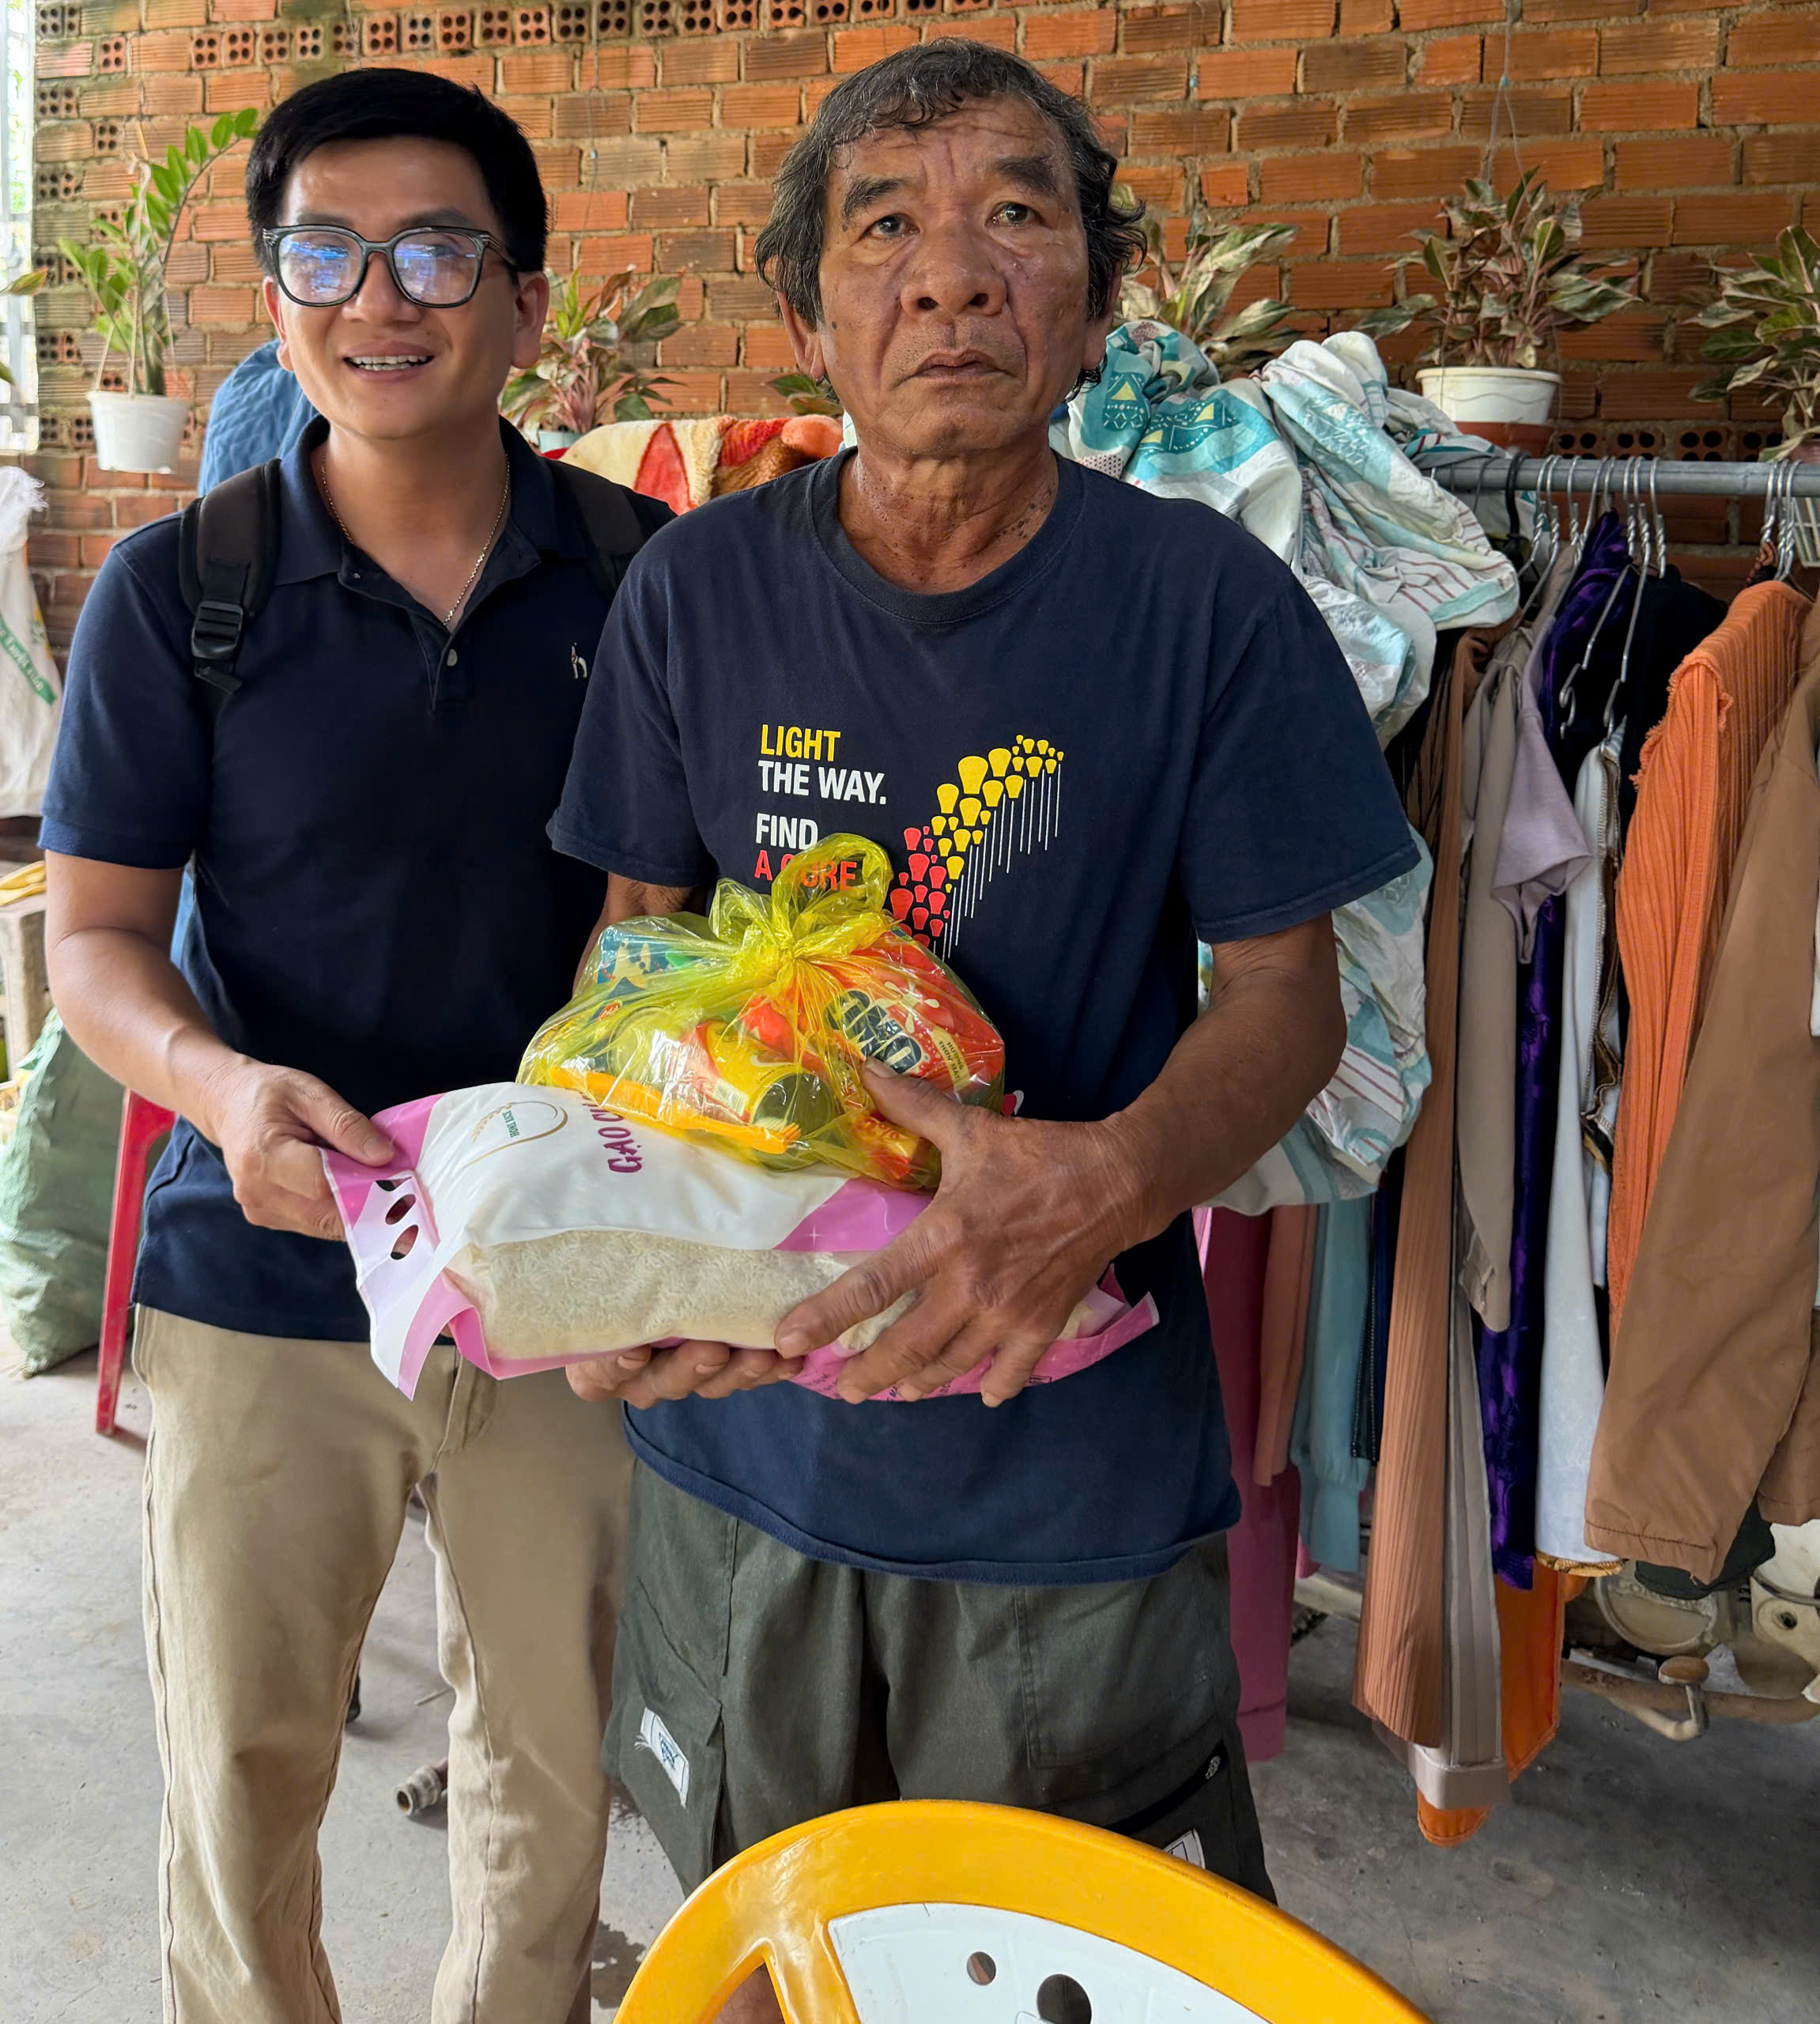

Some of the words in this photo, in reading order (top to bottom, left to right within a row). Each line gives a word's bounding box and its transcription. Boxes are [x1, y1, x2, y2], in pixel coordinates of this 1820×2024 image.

[761, 724, 840, 761] LIGHT
[758, 761, 810, 795] THE
[817, 767, 886, 804] WAY.
[756, 813, 817, 850] FIND
[754, 850, 772, 880] A
[598, 1127, 642, 1173] GẠO
